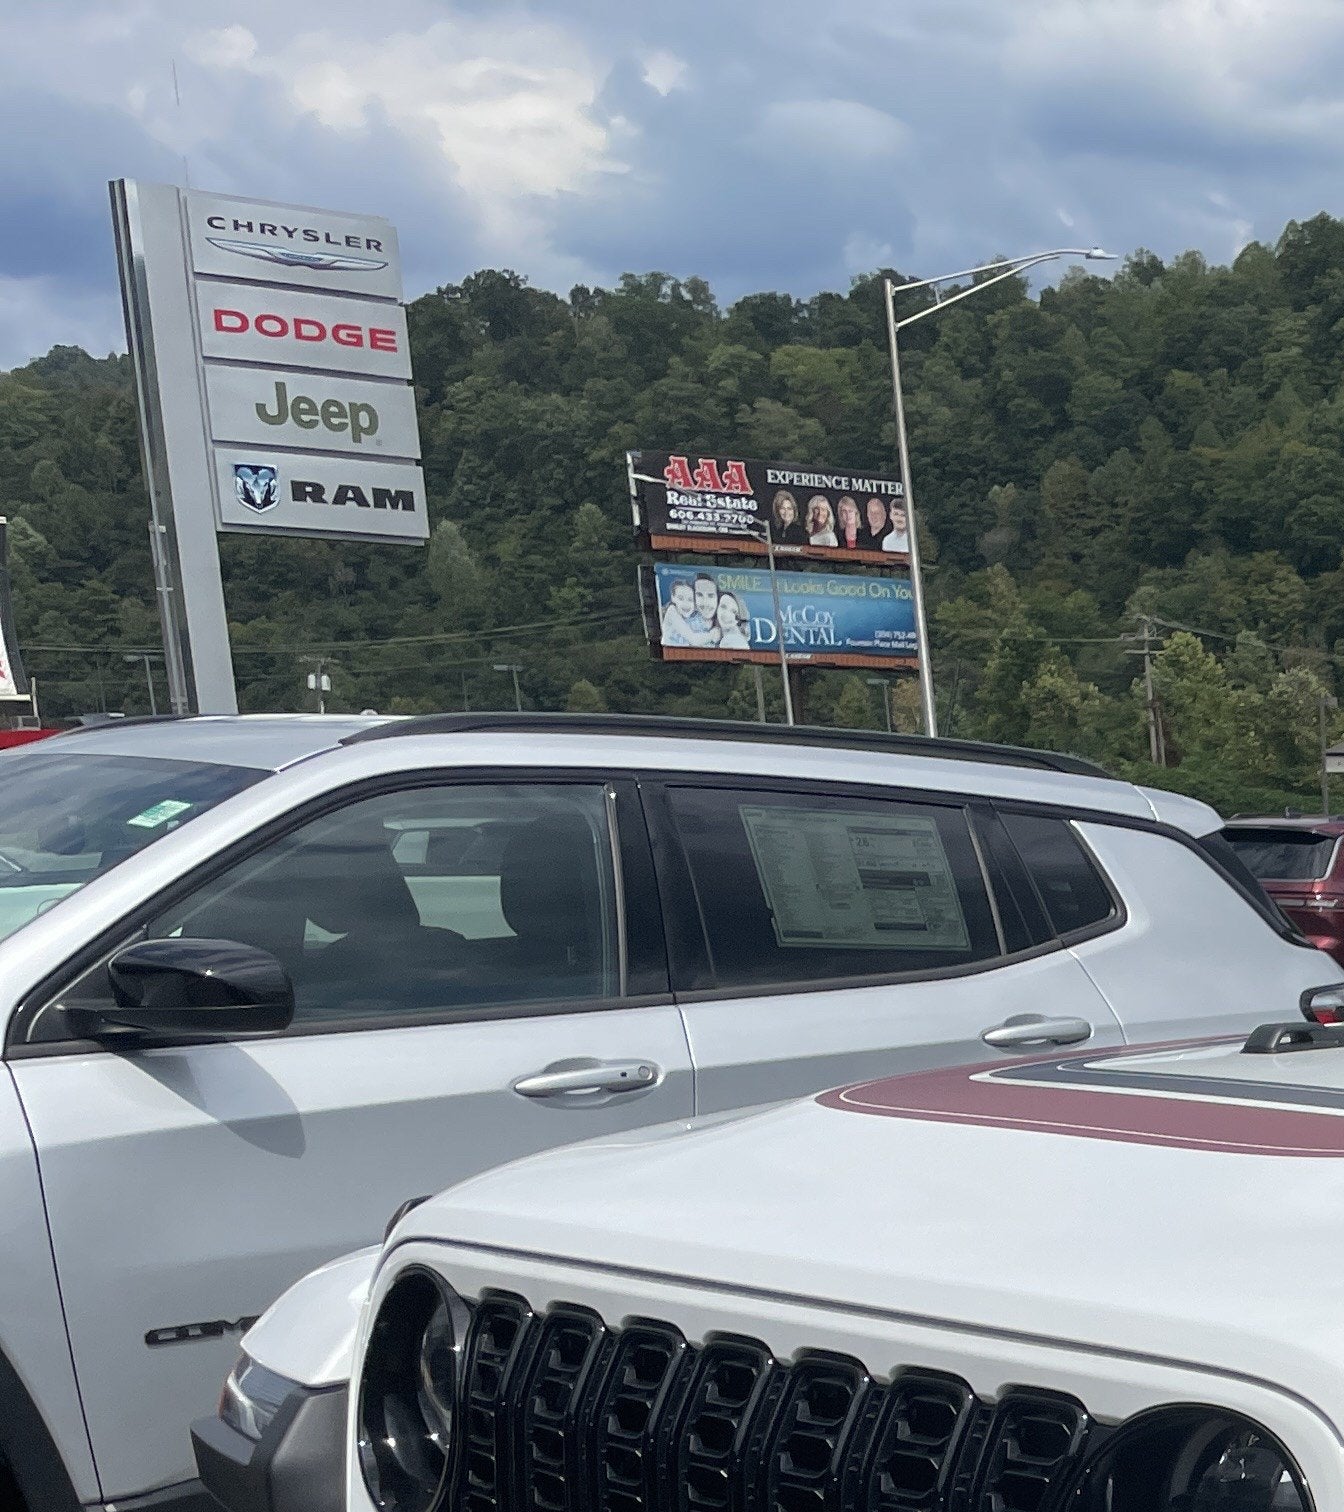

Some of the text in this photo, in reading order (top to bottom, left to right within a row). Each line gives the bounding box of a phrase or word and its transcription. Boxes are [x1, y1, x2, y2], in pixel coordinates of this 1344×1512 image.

[206, 215, 383, 253] CHRYSLER
[213, 308, 399, 353] DODGE
[255, 381, 379, 444] Jeep
[663, 455, 754, 496] AAA
[766, 468, 850, 491] EXPERIENCE
[290, 479, 416, 513] RAM
[869, 581, 890, 598] On
